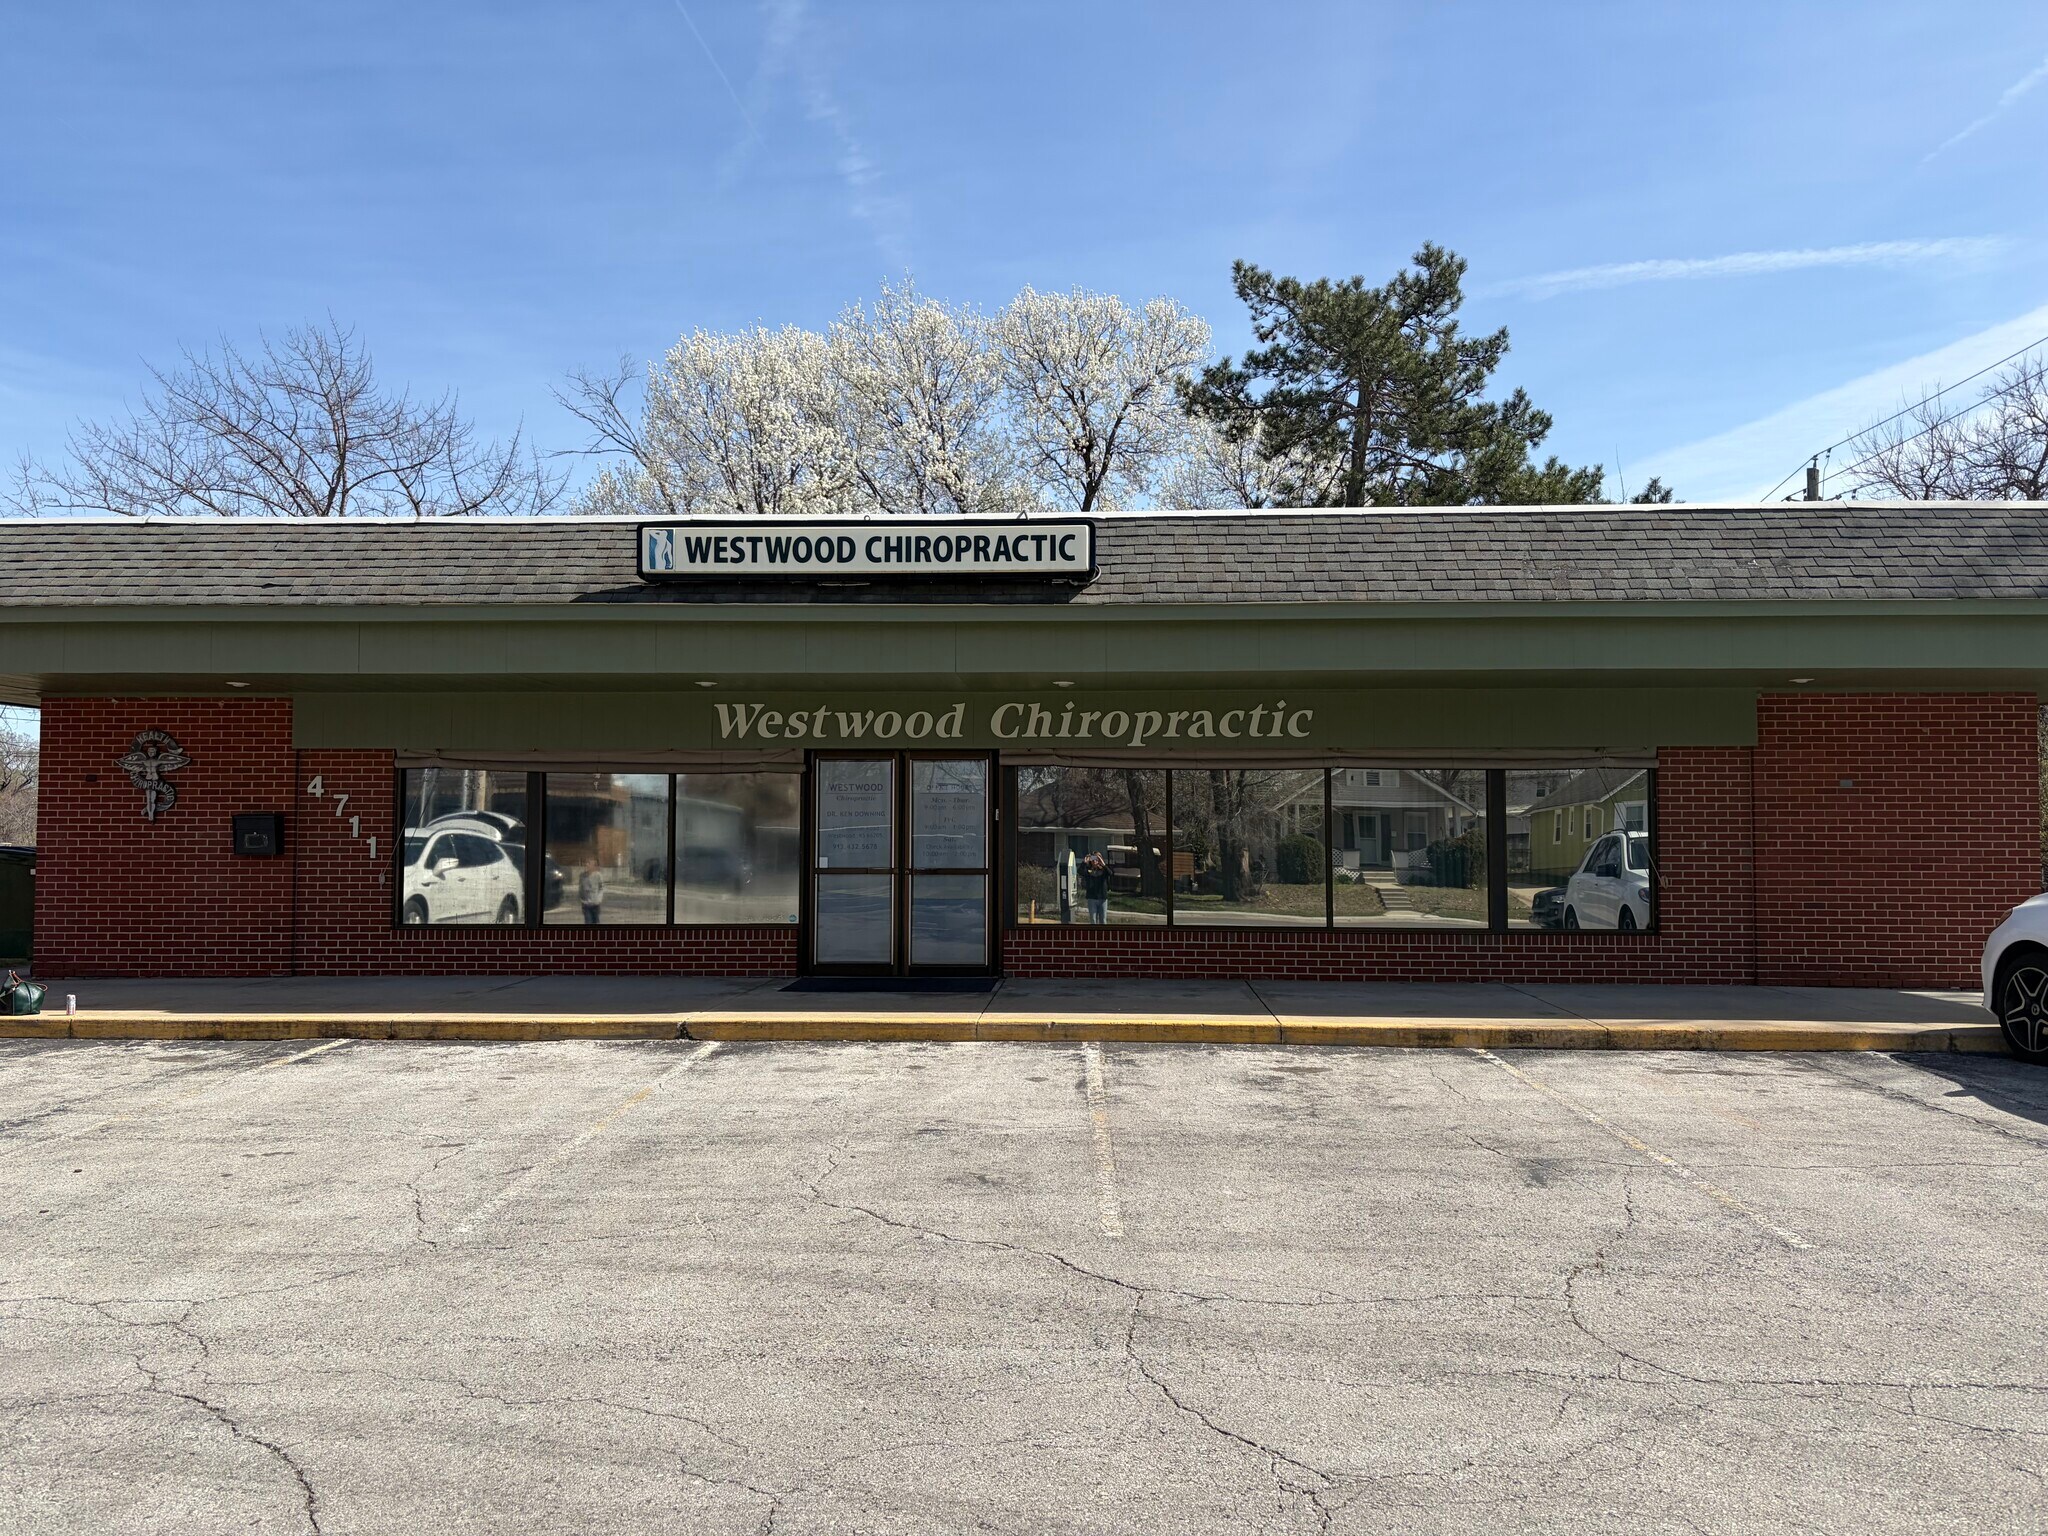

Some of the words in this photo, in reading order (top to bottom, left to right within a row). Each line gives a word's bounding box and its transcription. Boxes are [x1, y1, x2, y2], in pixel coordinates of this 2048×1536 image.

[684, 536, 857, 564] WESTWOOD
[865, 534, 1077, 563] CHIROPRACTIC
[136, 731, 171, 745] HEALTH
[713, 703, 966, 739] Westwood
[990, 700, 1314, 748] Chiropractic
[130, 771, 175, 801] CHIROPRACTIC
[829, 783, 884, 792] WESTWOOD
[307, 775, 378, 859] 4711
